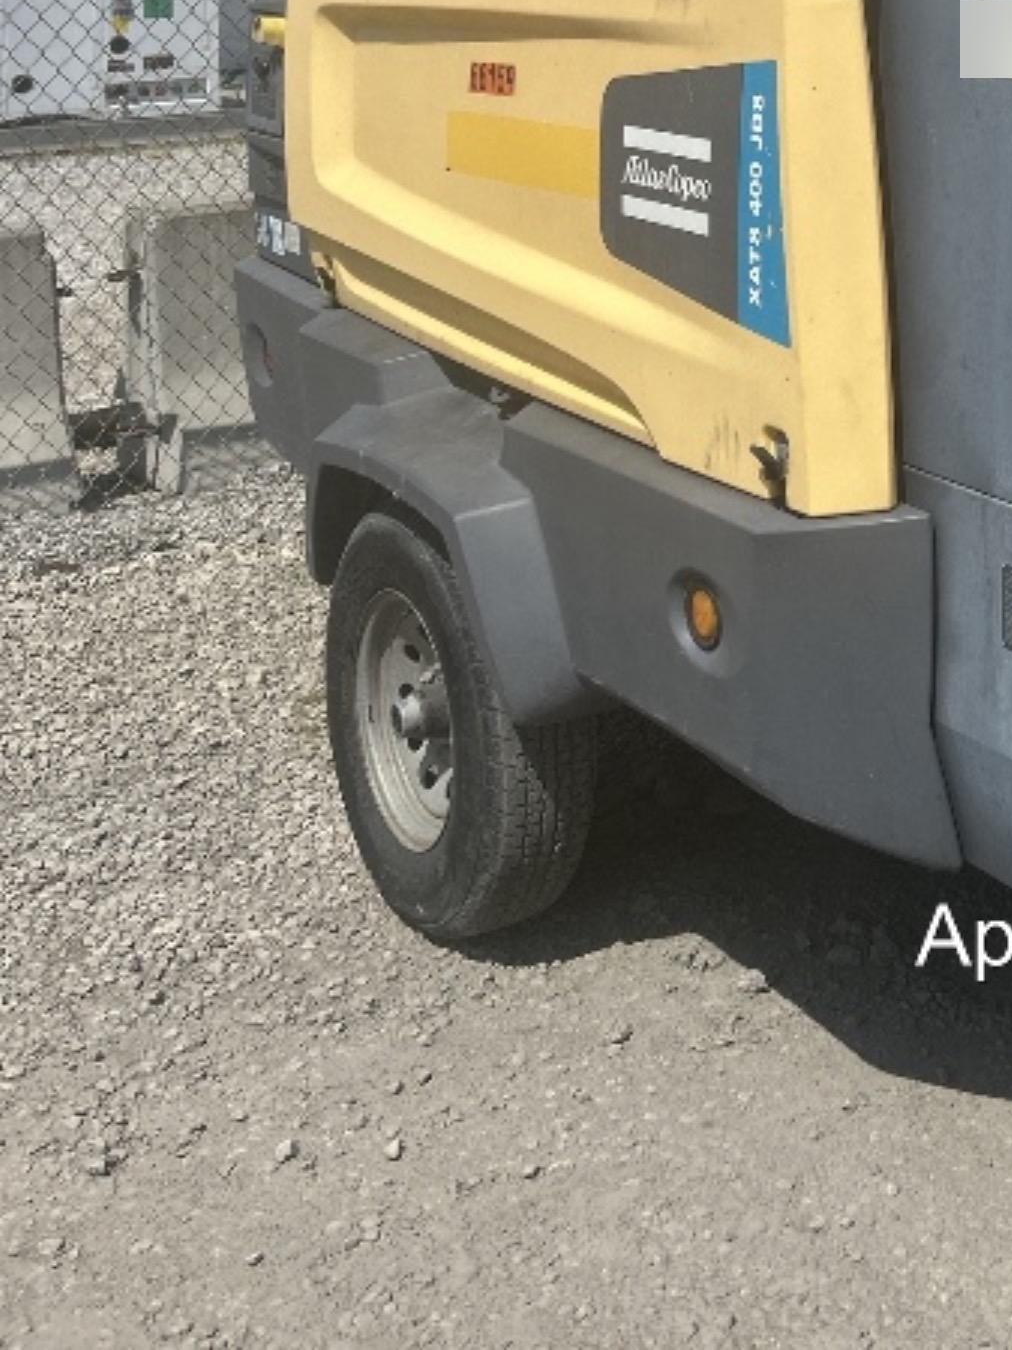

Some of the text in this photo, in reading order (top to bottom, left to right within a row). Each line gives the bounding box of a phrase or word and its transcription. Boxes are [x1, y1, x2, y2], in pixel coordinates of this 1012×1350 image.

[620, 155, 712, 202] Atlas Copco
[749, 161, 763, 217] 400
